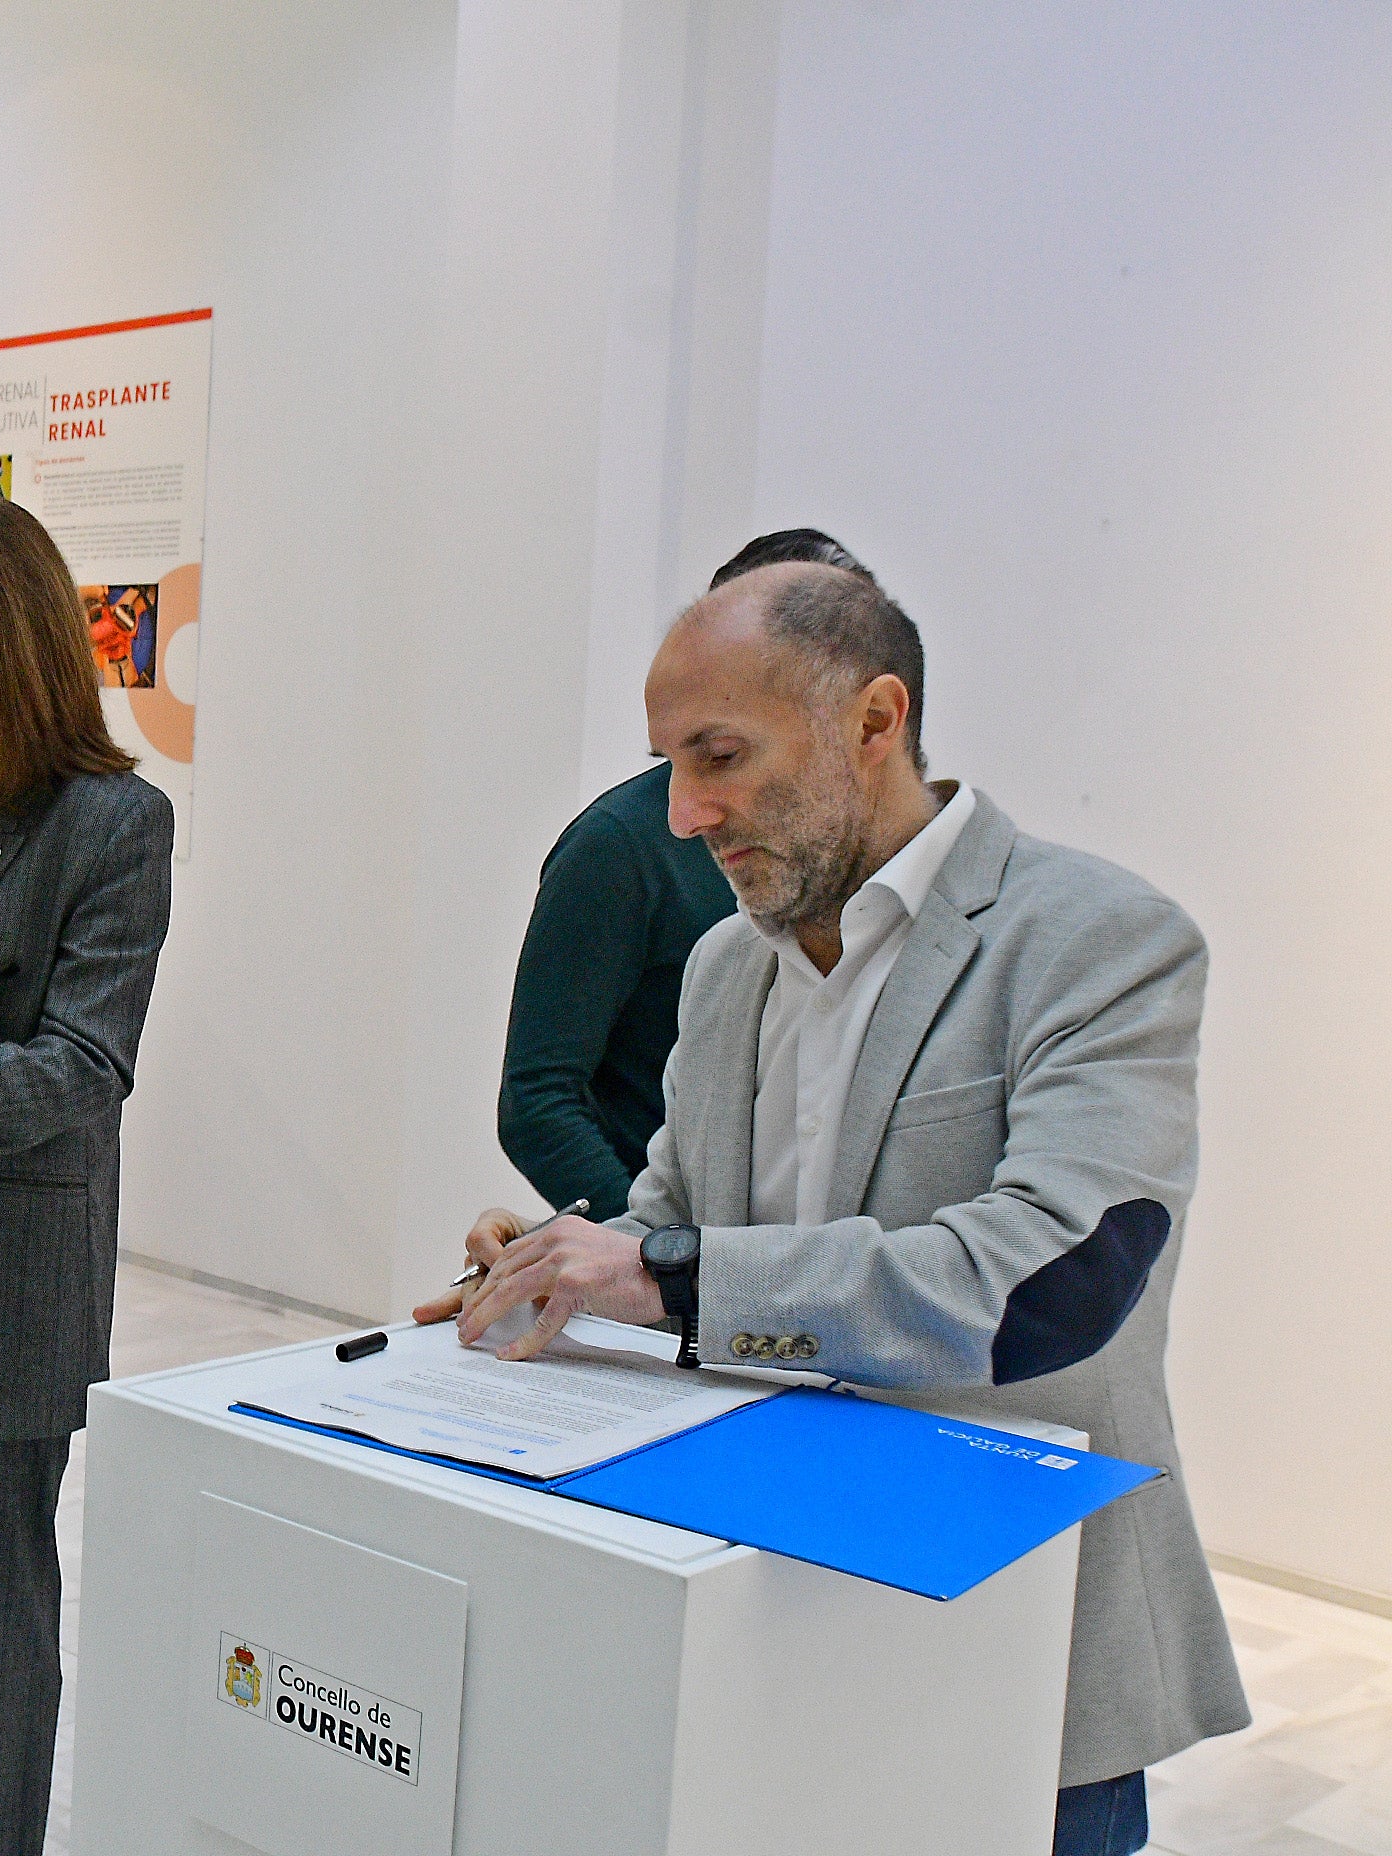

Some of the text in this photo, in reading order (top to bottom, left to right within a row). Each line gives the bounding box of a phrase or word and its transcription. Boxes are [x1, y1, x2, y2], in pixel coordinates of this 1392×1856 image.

[50, 381, 171, 412] TRASPLANTE
[48, 419, 106, 442] RENAL
[969, 1441, 1030, 1461] XUNTA
[278, 1664, 392, 1729] Concello de
[276, 1695, 412, 1777] OURENSE
